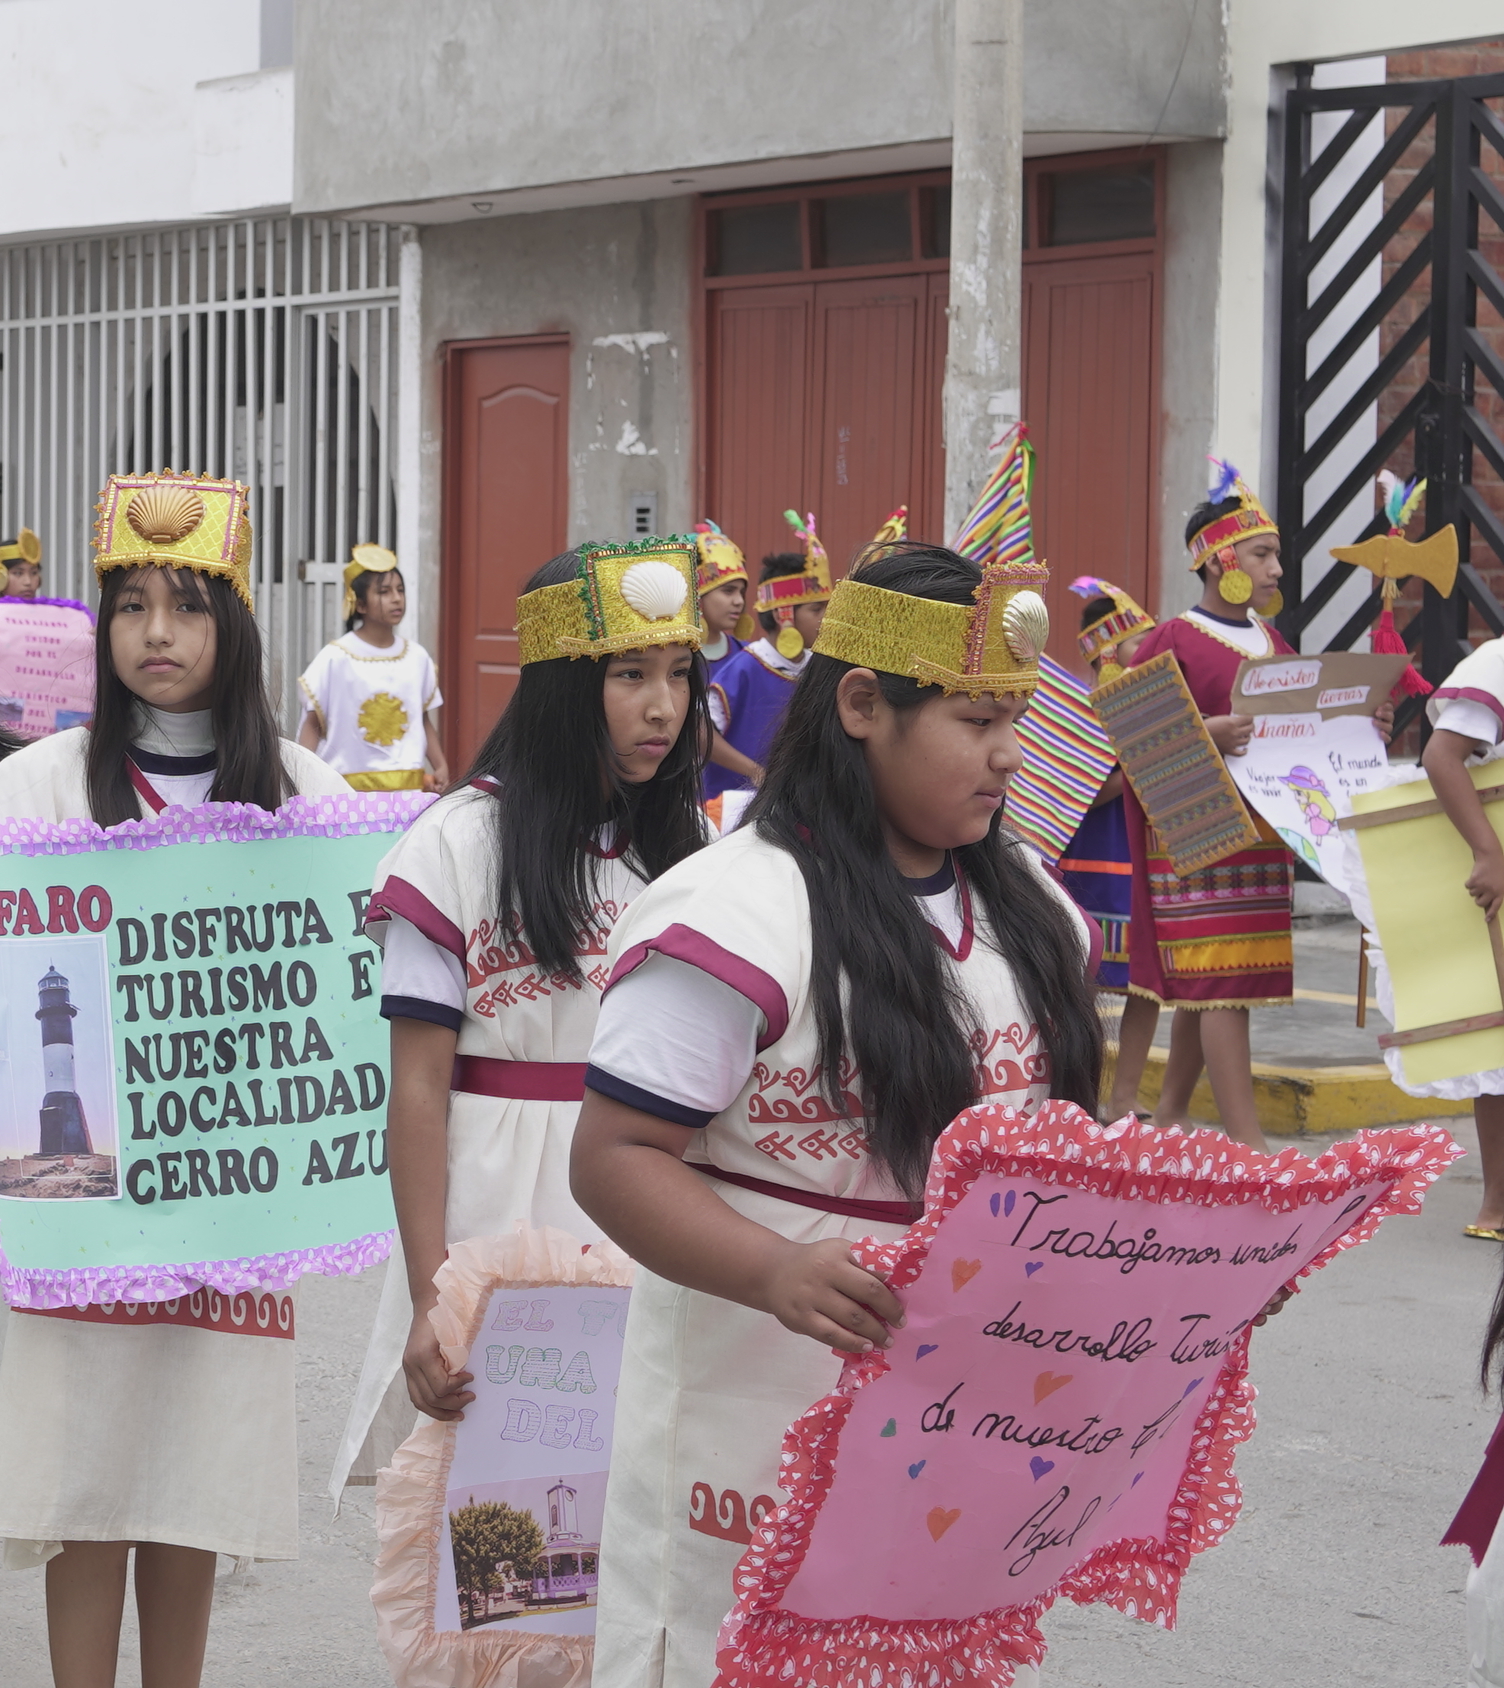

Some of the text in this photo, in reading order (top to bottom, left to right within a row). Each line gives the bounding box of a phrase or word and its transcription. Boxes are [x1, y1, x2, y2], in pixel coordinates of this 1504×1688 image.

[116, 898, 334, 966] DISFRUTA
[116, 950, 385, 1022] TURISMO E
[124, 1016, 334, 1084] NUESTRA
[127, 1062, 386, 1141] LOCALIDAD
[126, 1146, 279, 1205] CERRO
[491, 1299, 554, 1333] EL
[982, 1300, 1158, 1363] desarrollo
[501, 1398, 605, 1452] DEL
